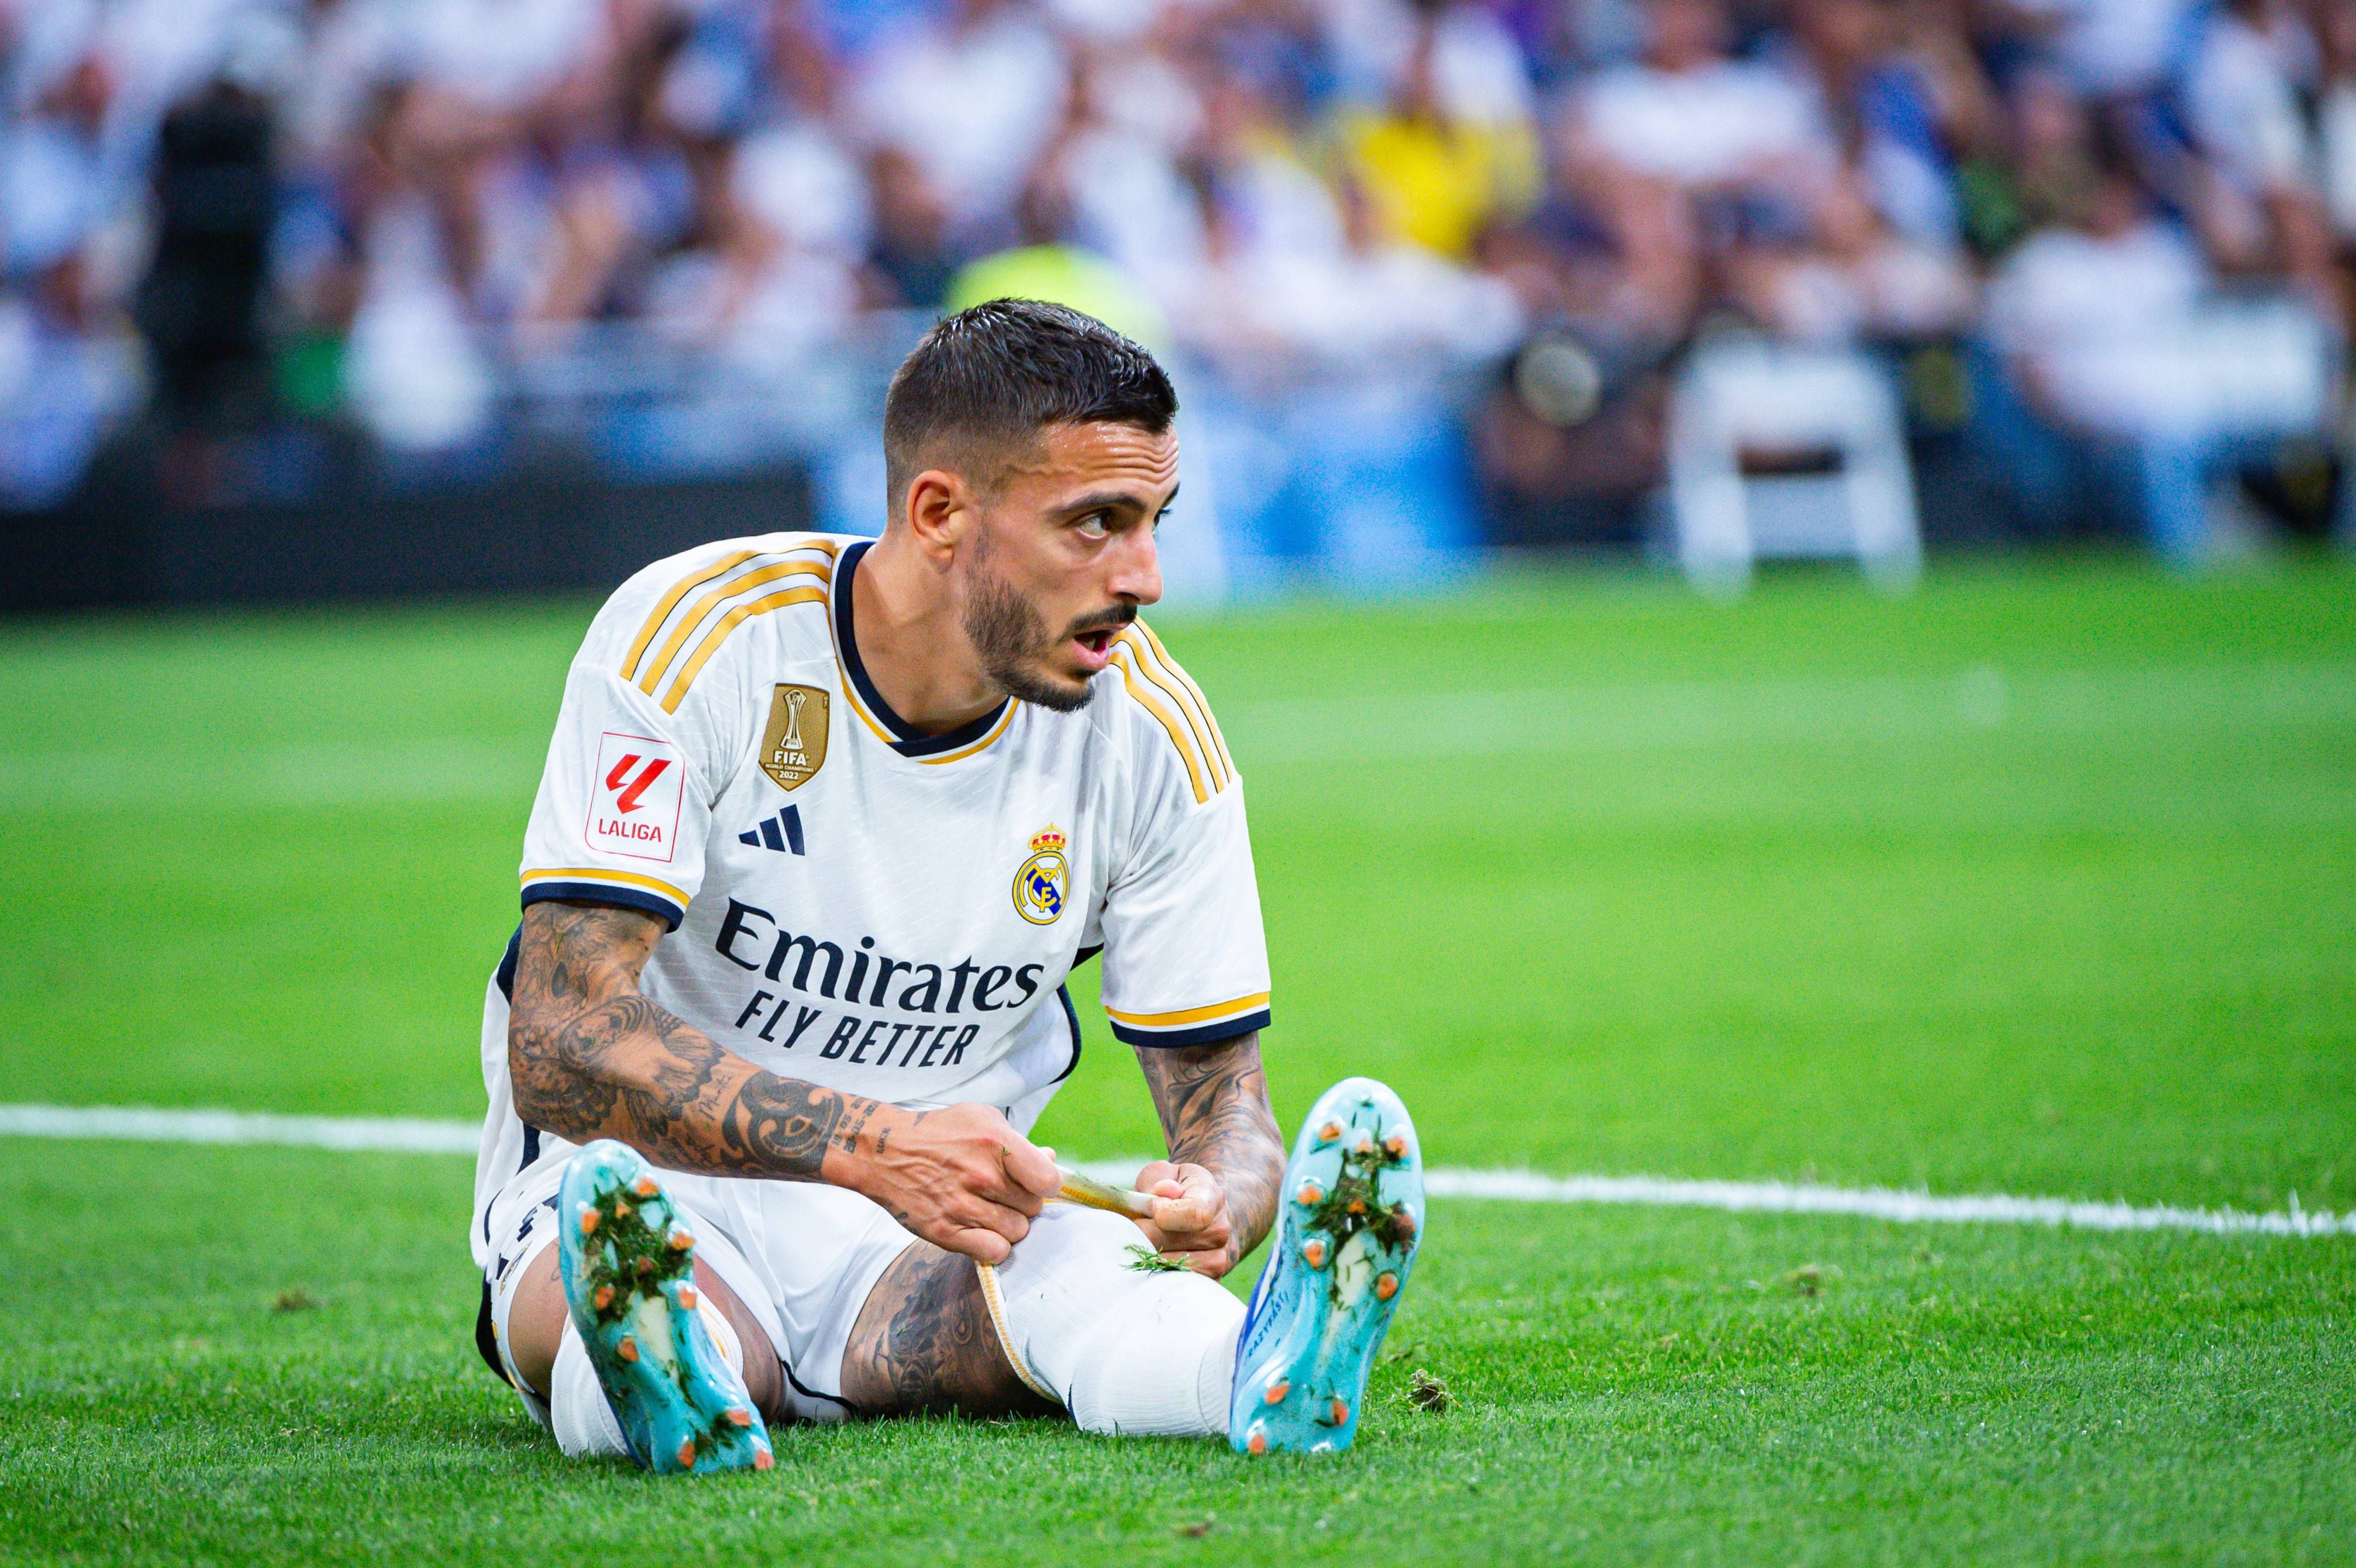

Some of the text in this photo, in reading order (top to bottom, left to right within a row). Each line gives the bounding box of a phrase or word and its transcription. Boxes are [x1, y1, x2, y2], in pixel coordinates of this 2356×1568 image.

[774, 750, 807, 766] FIFA
[779, 771, 799, 780] 2022
[598, 818, 662, 843] LALIGA
[715, 896, 1045, 1014] Emirates
[735, 989, 980, 1068] FLY BETTER
